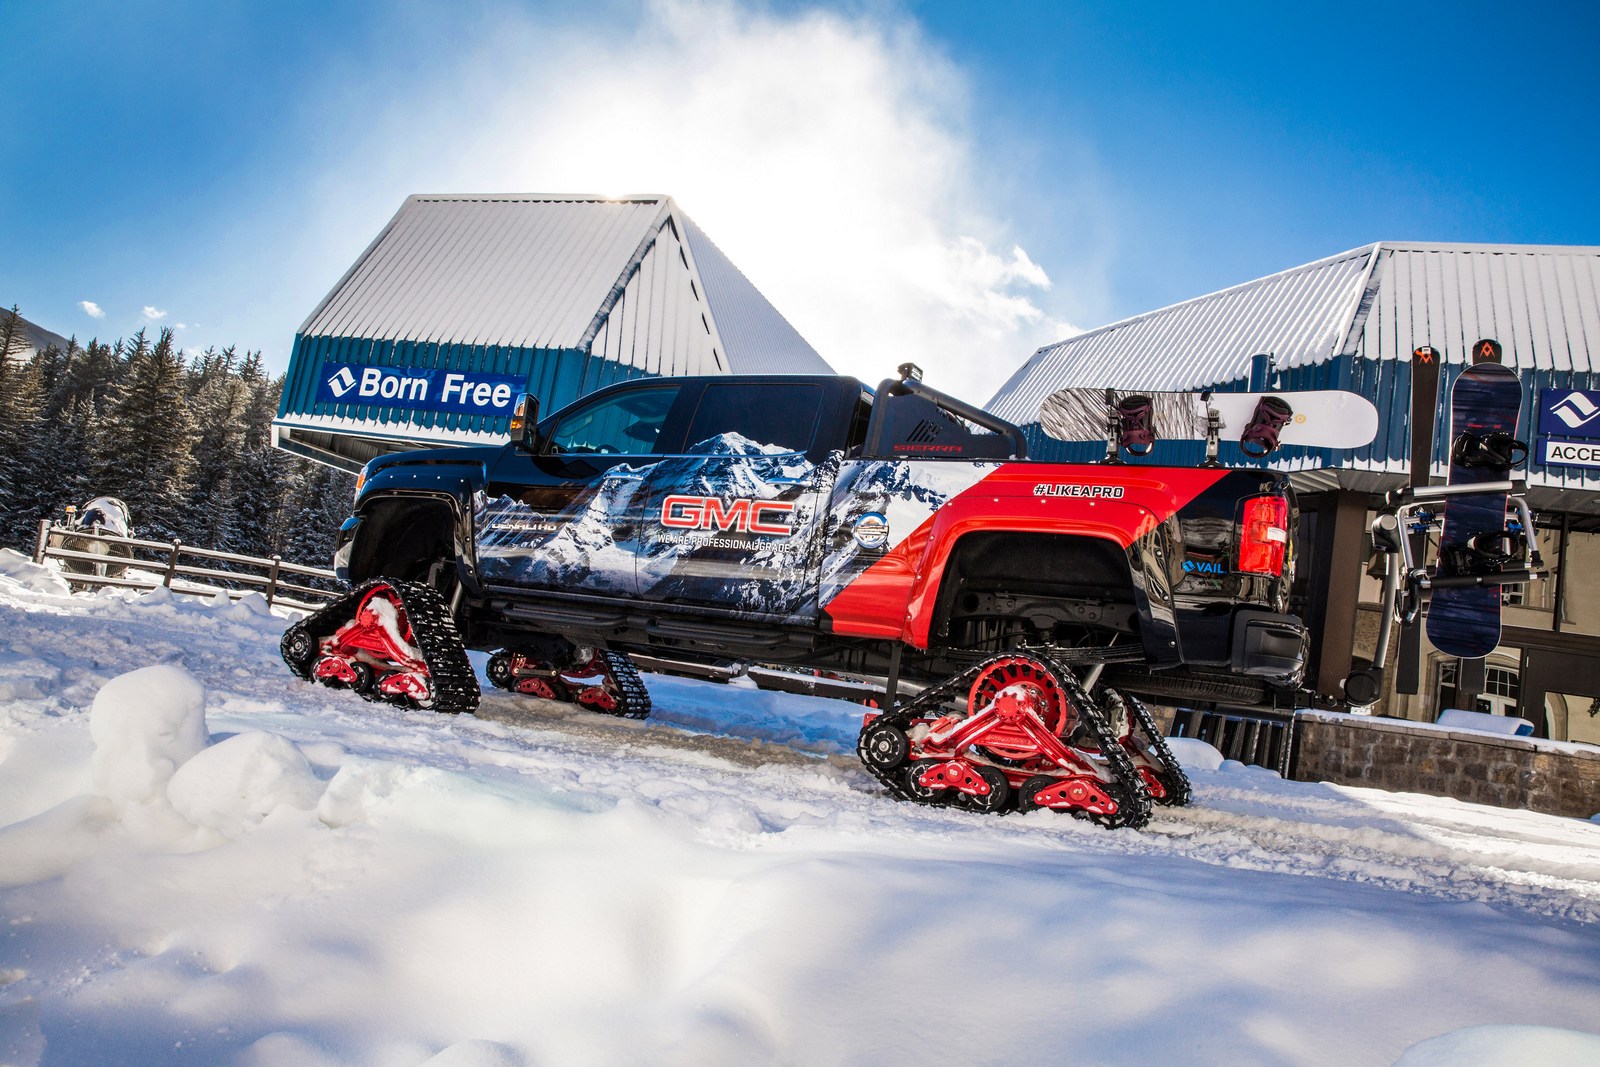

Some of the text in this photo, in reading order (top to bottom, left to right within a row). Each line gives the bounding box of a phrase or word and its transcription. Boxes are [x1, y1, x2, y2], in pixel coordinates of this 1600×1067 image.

[358, 367, 511, 408] Born Free
[893, 443, 963, 453] SIERRA
[1033, 483, 1125, 499] #LIKEAPRO
[661, 494, 795, 536] GMC
[658, 534, 791, 553] WE ARE PROFESSIONAL GRADE
[1196, 561, 1225, 574] VAIL
